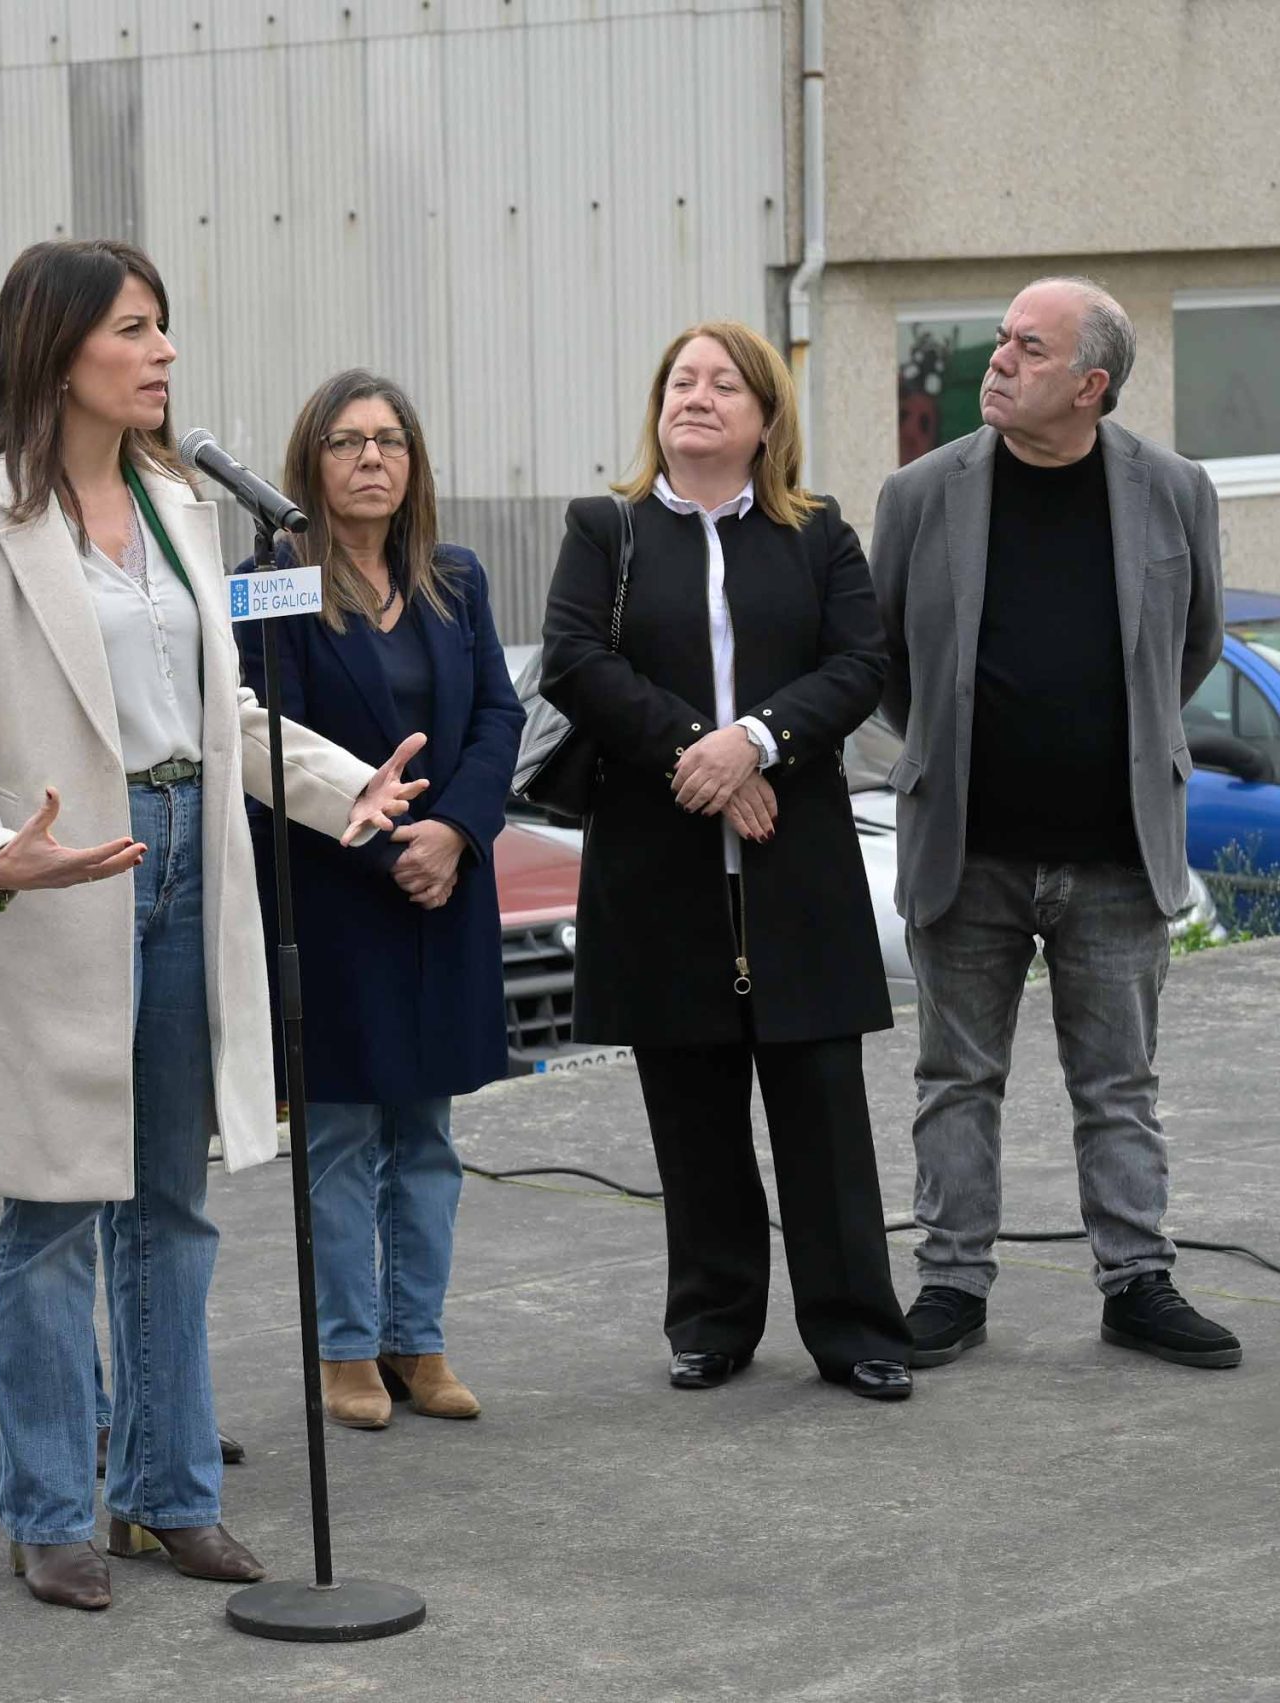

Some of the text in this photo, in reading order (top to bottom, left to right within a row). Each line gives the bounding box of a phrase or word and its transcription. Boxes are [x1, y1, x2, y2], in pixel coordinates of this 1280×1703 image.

[253, 578, 294, 594] XUNTA
[253, 592, 320, 611] DE GALICIA
